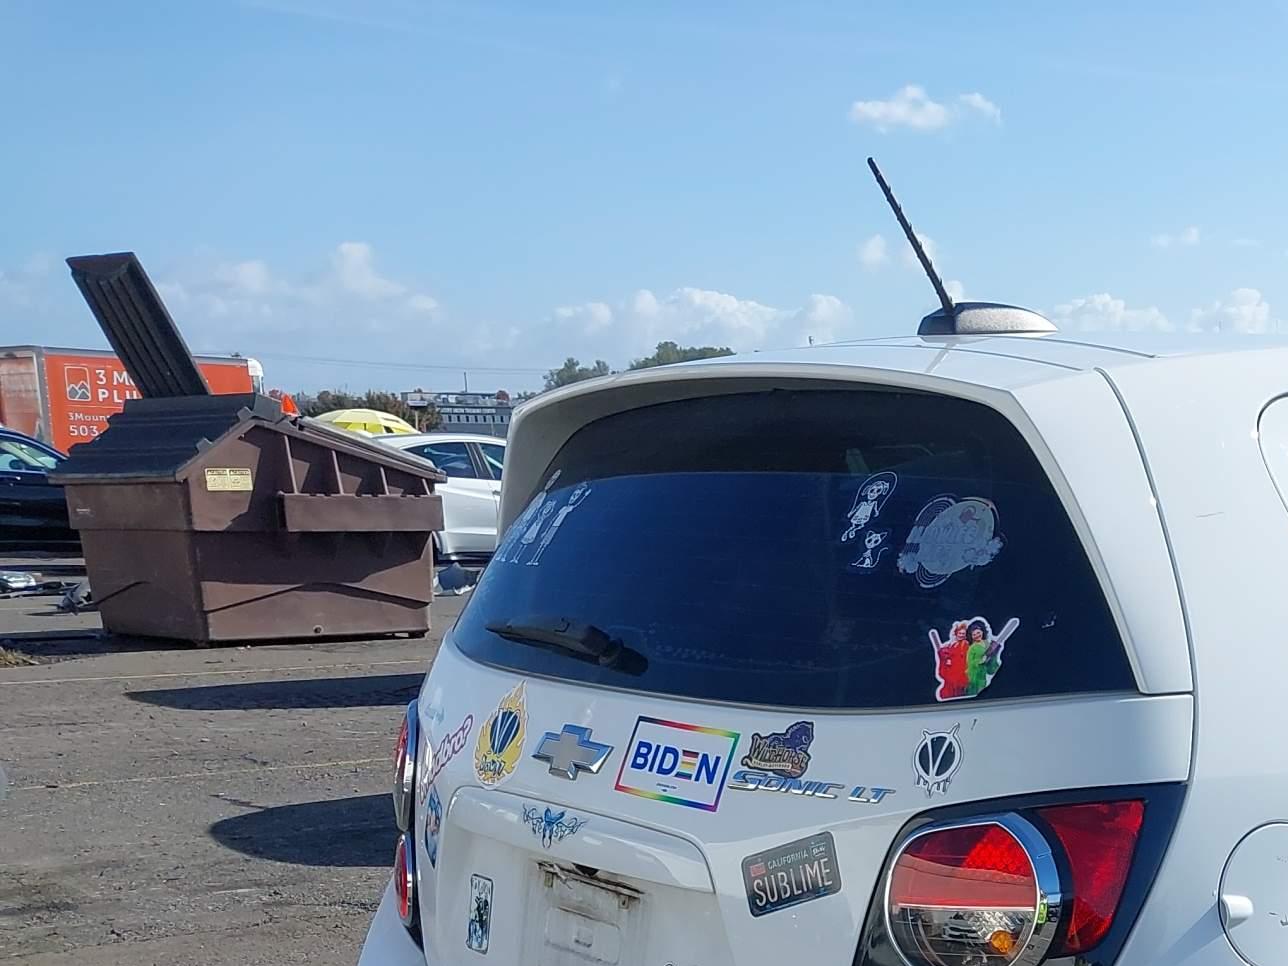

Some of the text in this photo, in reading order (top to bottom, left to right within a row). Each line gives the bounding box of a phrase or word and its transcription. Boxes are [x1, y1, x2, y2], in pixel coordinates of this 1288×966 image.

[95, 369, 107, 385] 3
[68, 412, 110, 422] 3Moun
[630, 740, 721, 785] BIDEN
[727, 769, 897, 805] SONIC LT
[767, 849, 809, 870] CALIFORNIA
[753, 858, 833, 907] SUBLIME
